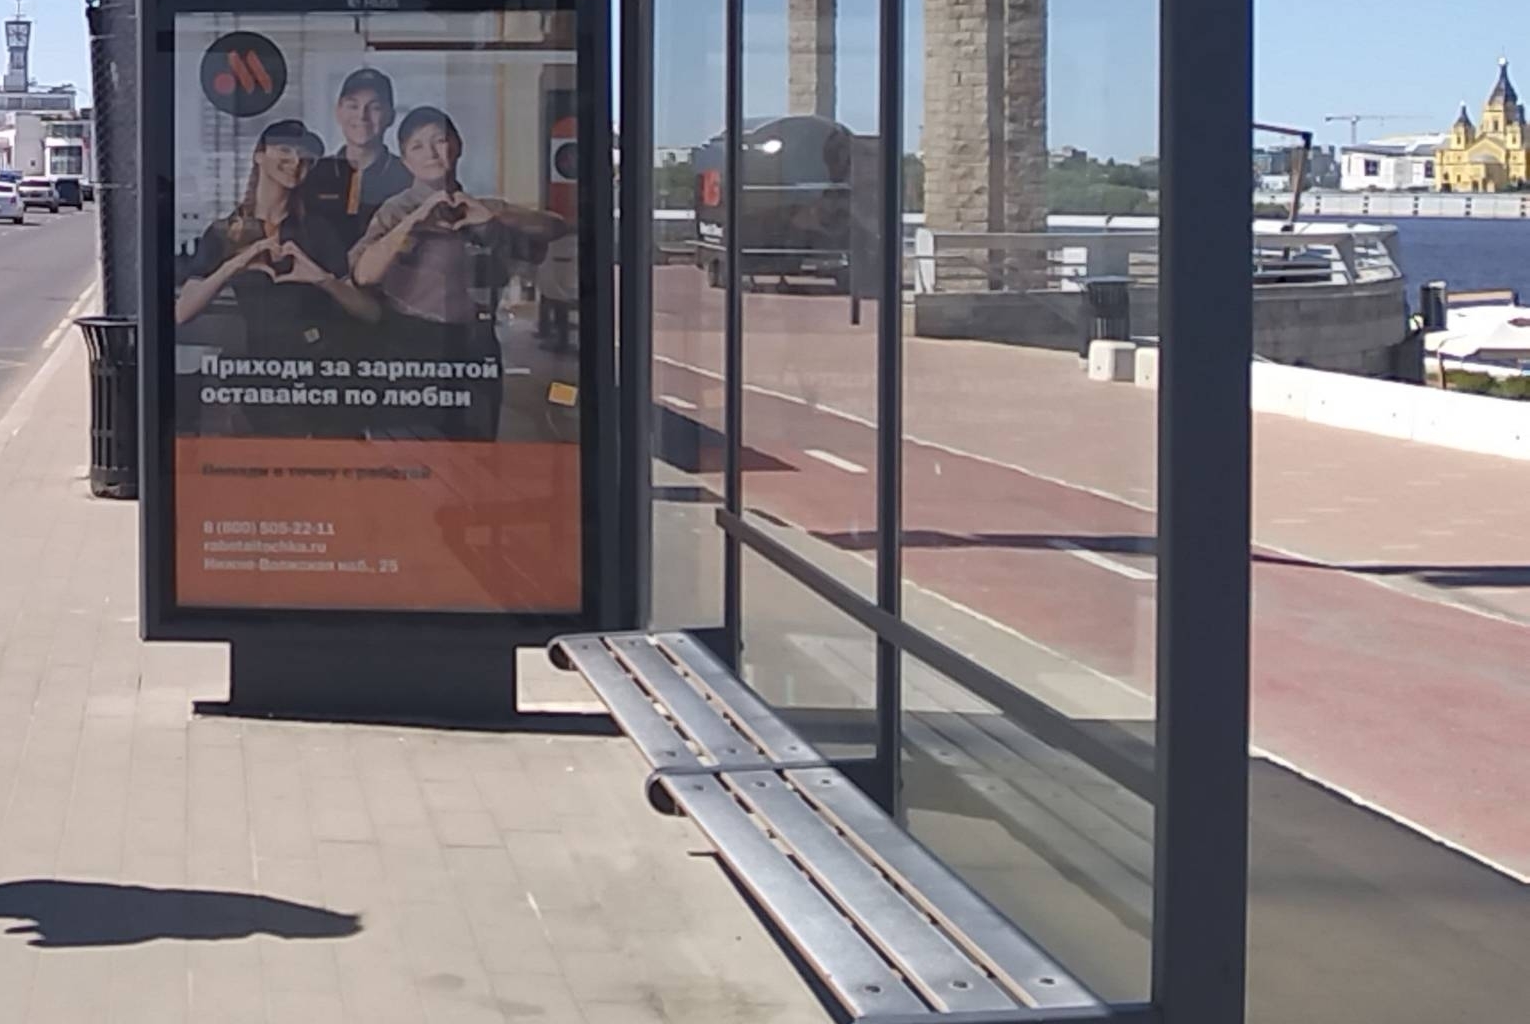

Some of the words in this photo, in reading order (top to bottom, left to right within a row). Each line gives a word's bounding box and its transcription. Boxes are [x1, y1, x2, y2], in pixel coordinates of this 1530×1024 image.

[201, 355, 314, 379] Приходи
[320, 360, 351, 377] за
[357, 357, 498, 381] зарплатой
[201, 382, 338, 404] оставайся
[344, 389, 377, 405] по
[382, 386, 471, 407] любви
